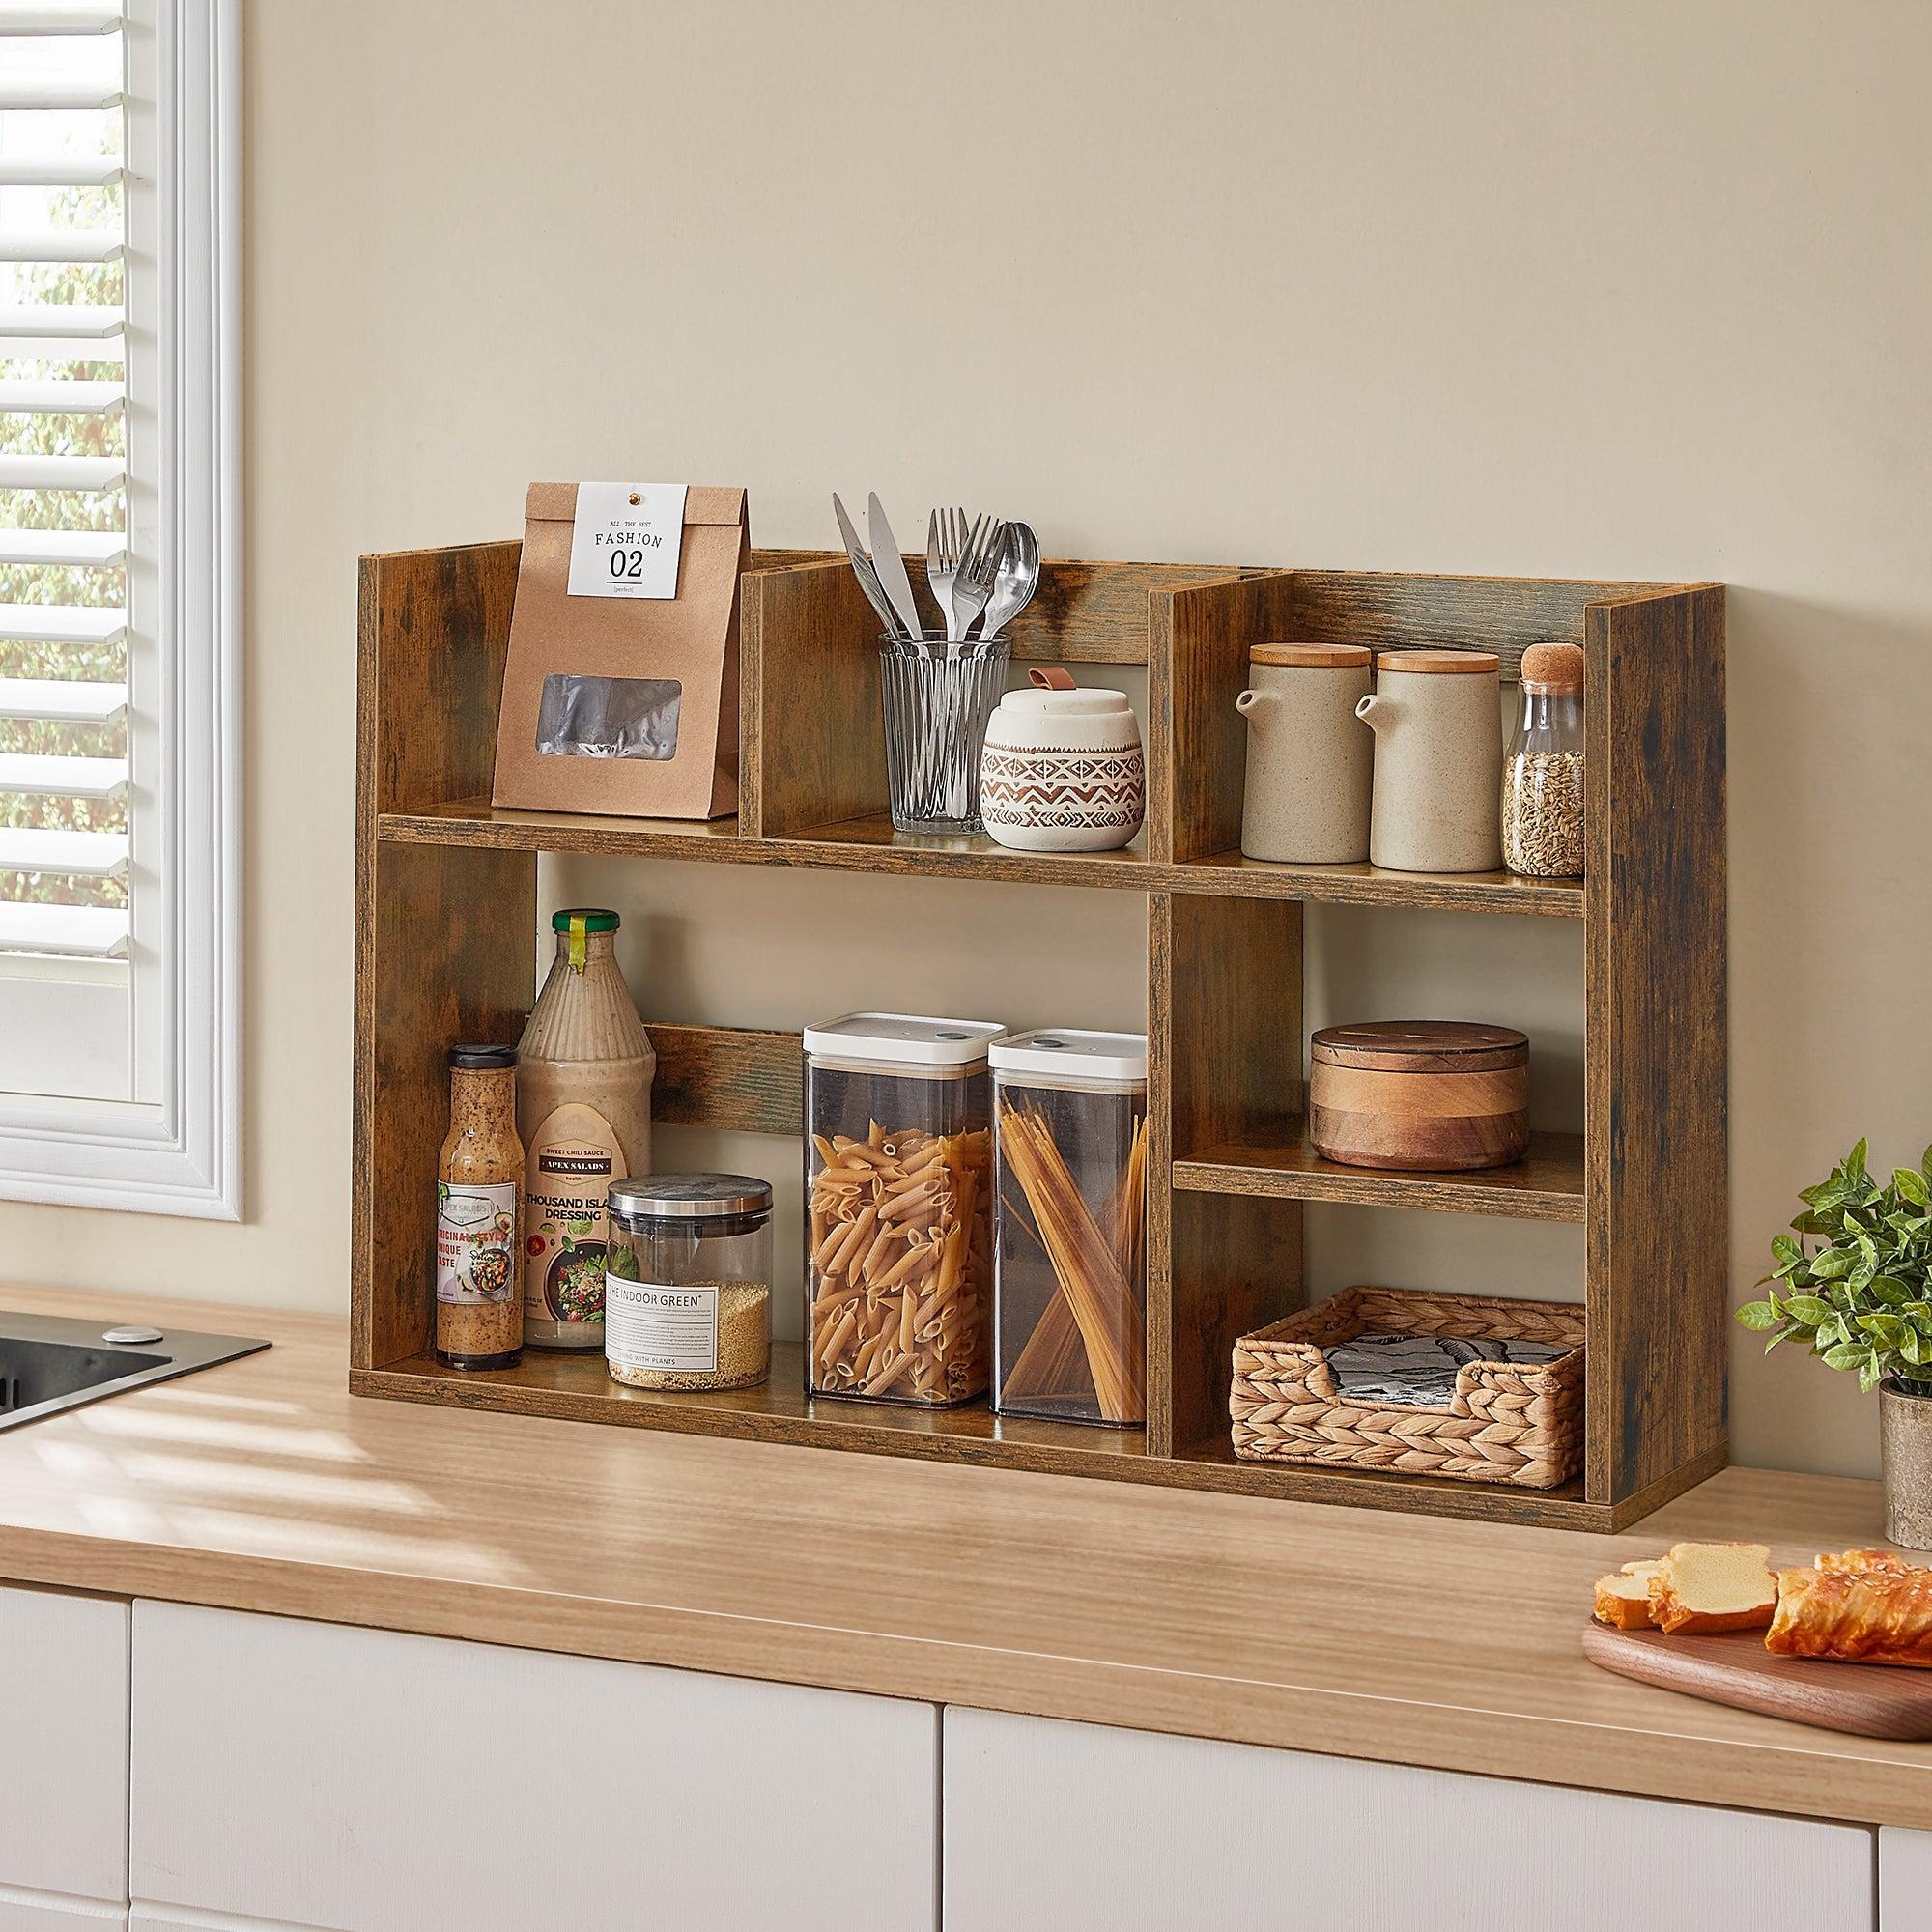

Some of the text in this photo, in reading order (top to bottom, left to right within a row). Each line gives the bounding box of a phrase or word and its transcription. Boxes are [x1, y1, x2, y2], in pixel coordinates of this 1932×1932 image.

[595, 532, 663, 548] FASHION
[611, 550, 643, 577] 02
[547, 1160, 569, 1169] APEX
[526, 1193, 609, 1208] THOUSAND ISLA
[545, 1209, 602, 1221] DRESSING
[610, 1284, 619, 1298] THE
[620, 1290, 657, 1304] INDOOR
